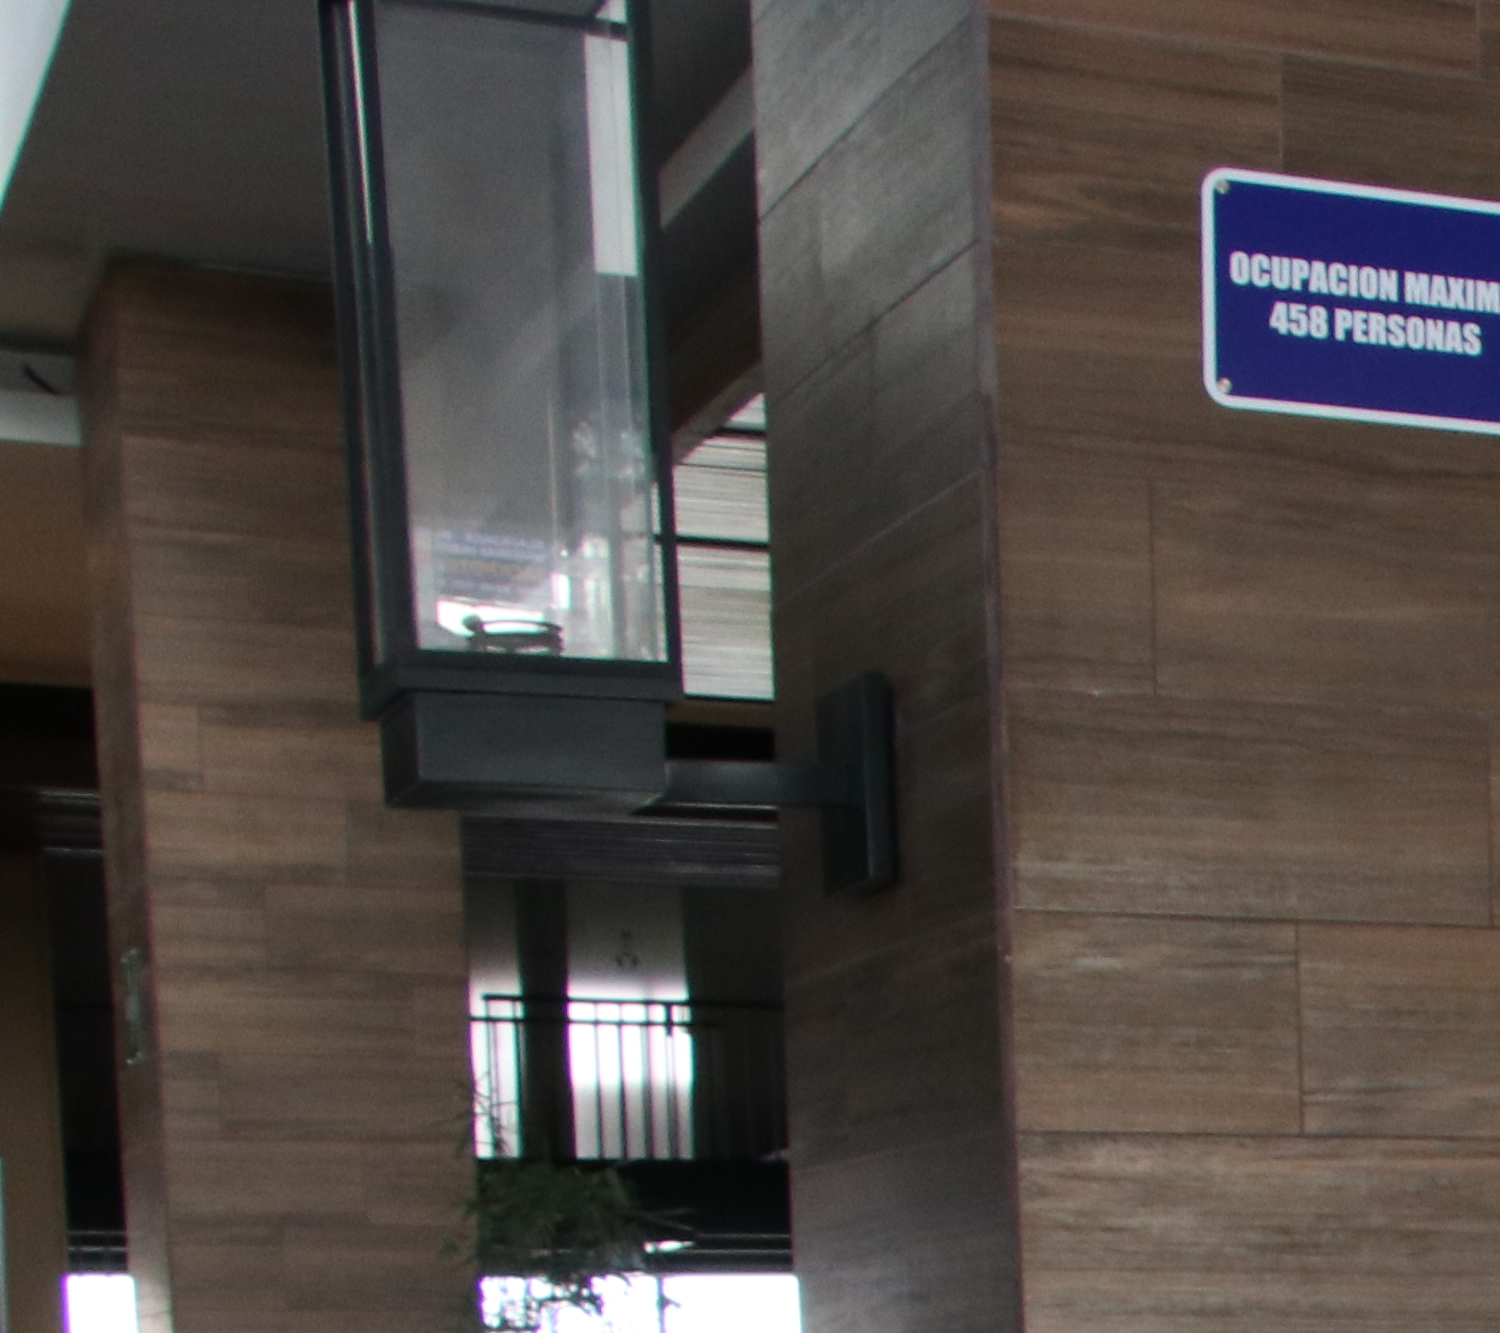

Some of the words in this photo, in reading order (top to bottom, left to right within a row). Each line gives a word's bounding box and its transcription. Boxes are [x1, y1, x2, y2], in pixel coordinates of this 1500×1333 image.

[1229, 250, 1399, 302] OCUPACION
[1269, 301, 1328, 340] 458
[1334, 307, 1483, 357] PERSONAS
